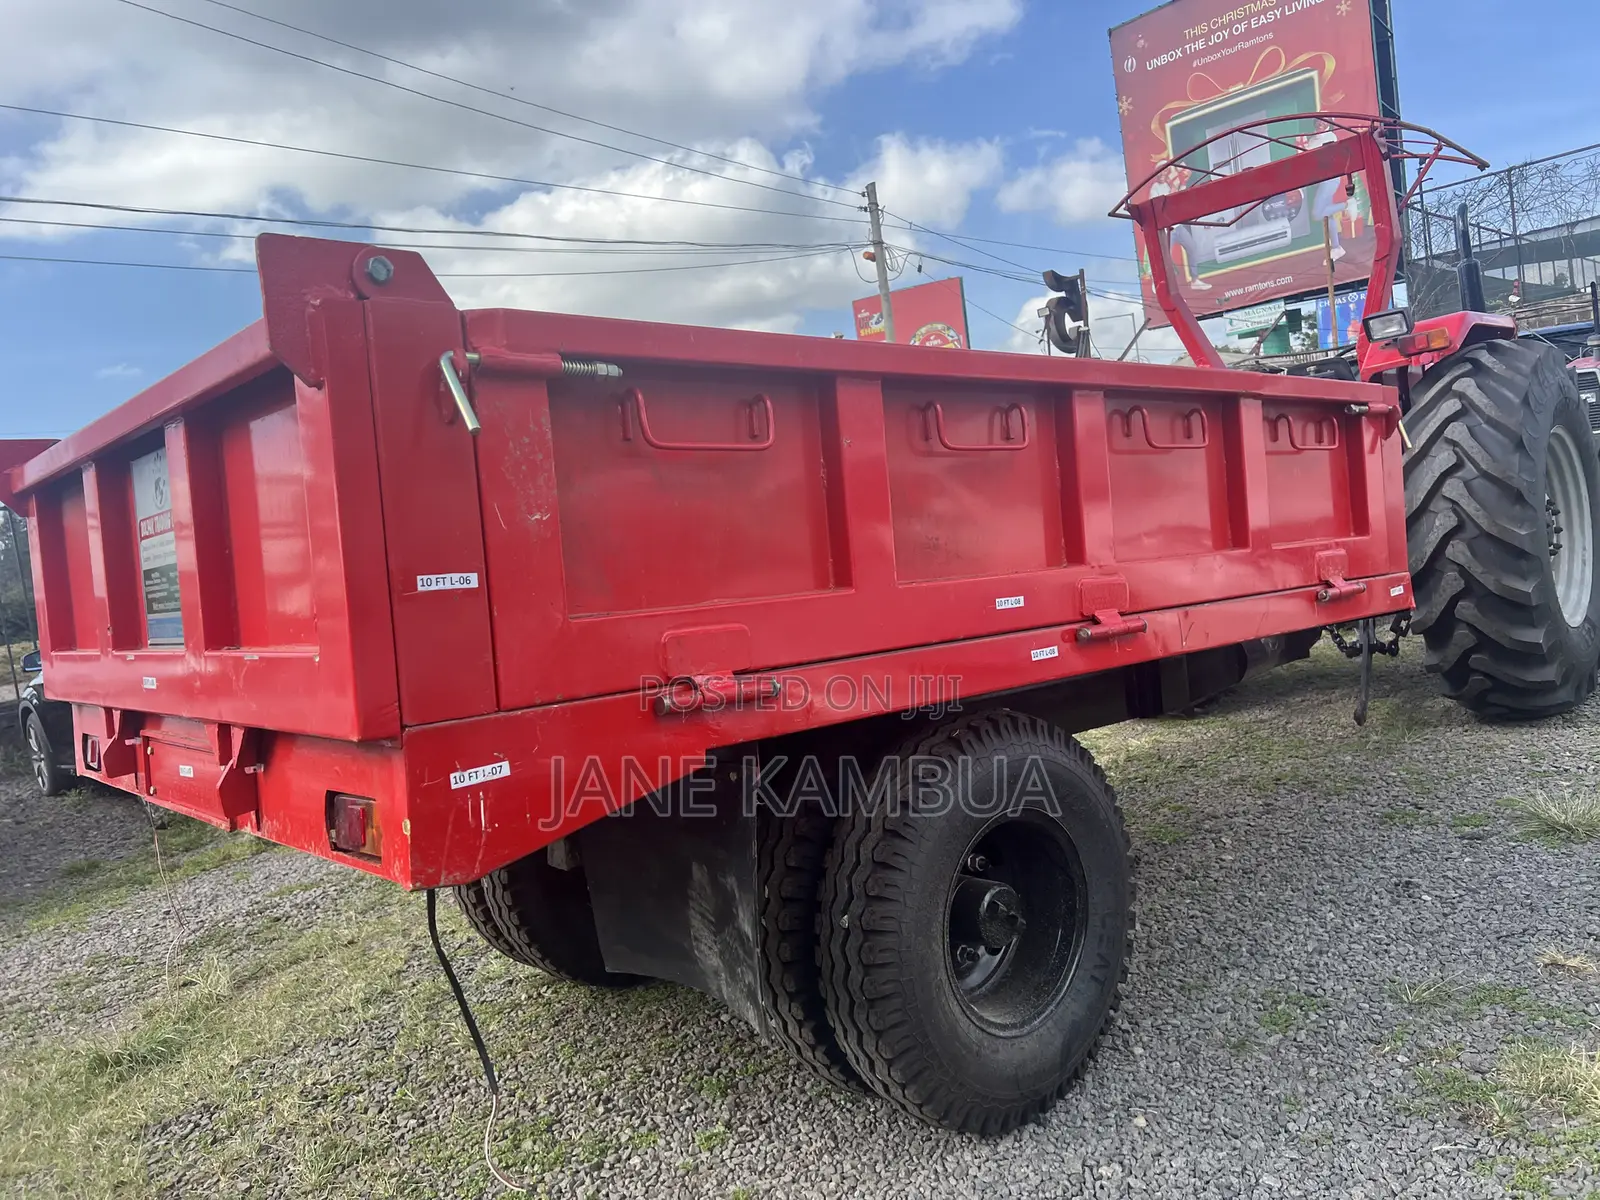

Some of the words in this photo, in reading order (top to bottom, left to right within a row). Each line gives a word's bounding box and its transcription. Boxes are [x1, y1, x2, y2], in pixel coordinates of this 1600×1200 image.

[1183, 23, 1208, 40] THIS
[1210, 0, 1276, 30] CHRISTMAS
[1146, 48, 1183, 71] UNBOX
[1184, 39, 1207, 55] THE
[1208, 31, 1230, 46] JOY
[1232, 22, 1250, 36] OF
[1250, 8, 1282, 29] EASY
[1192, 31, 1274, 68] #UnboxYourRamtons
[1224, 275, 1293, 298] www.ramtons.com
[419, 577, 433, 588] 10
[435, 576, 447, 587] FT
[449, 575, 472, 586] L-06
[997, 600, 1003, 608] 10
[1004, 599, 1010, 607] FT
[1032, 651, 1039, 659] 10
[453, 774, 466, 787] 10
[468, 770, 480, 782] FT
